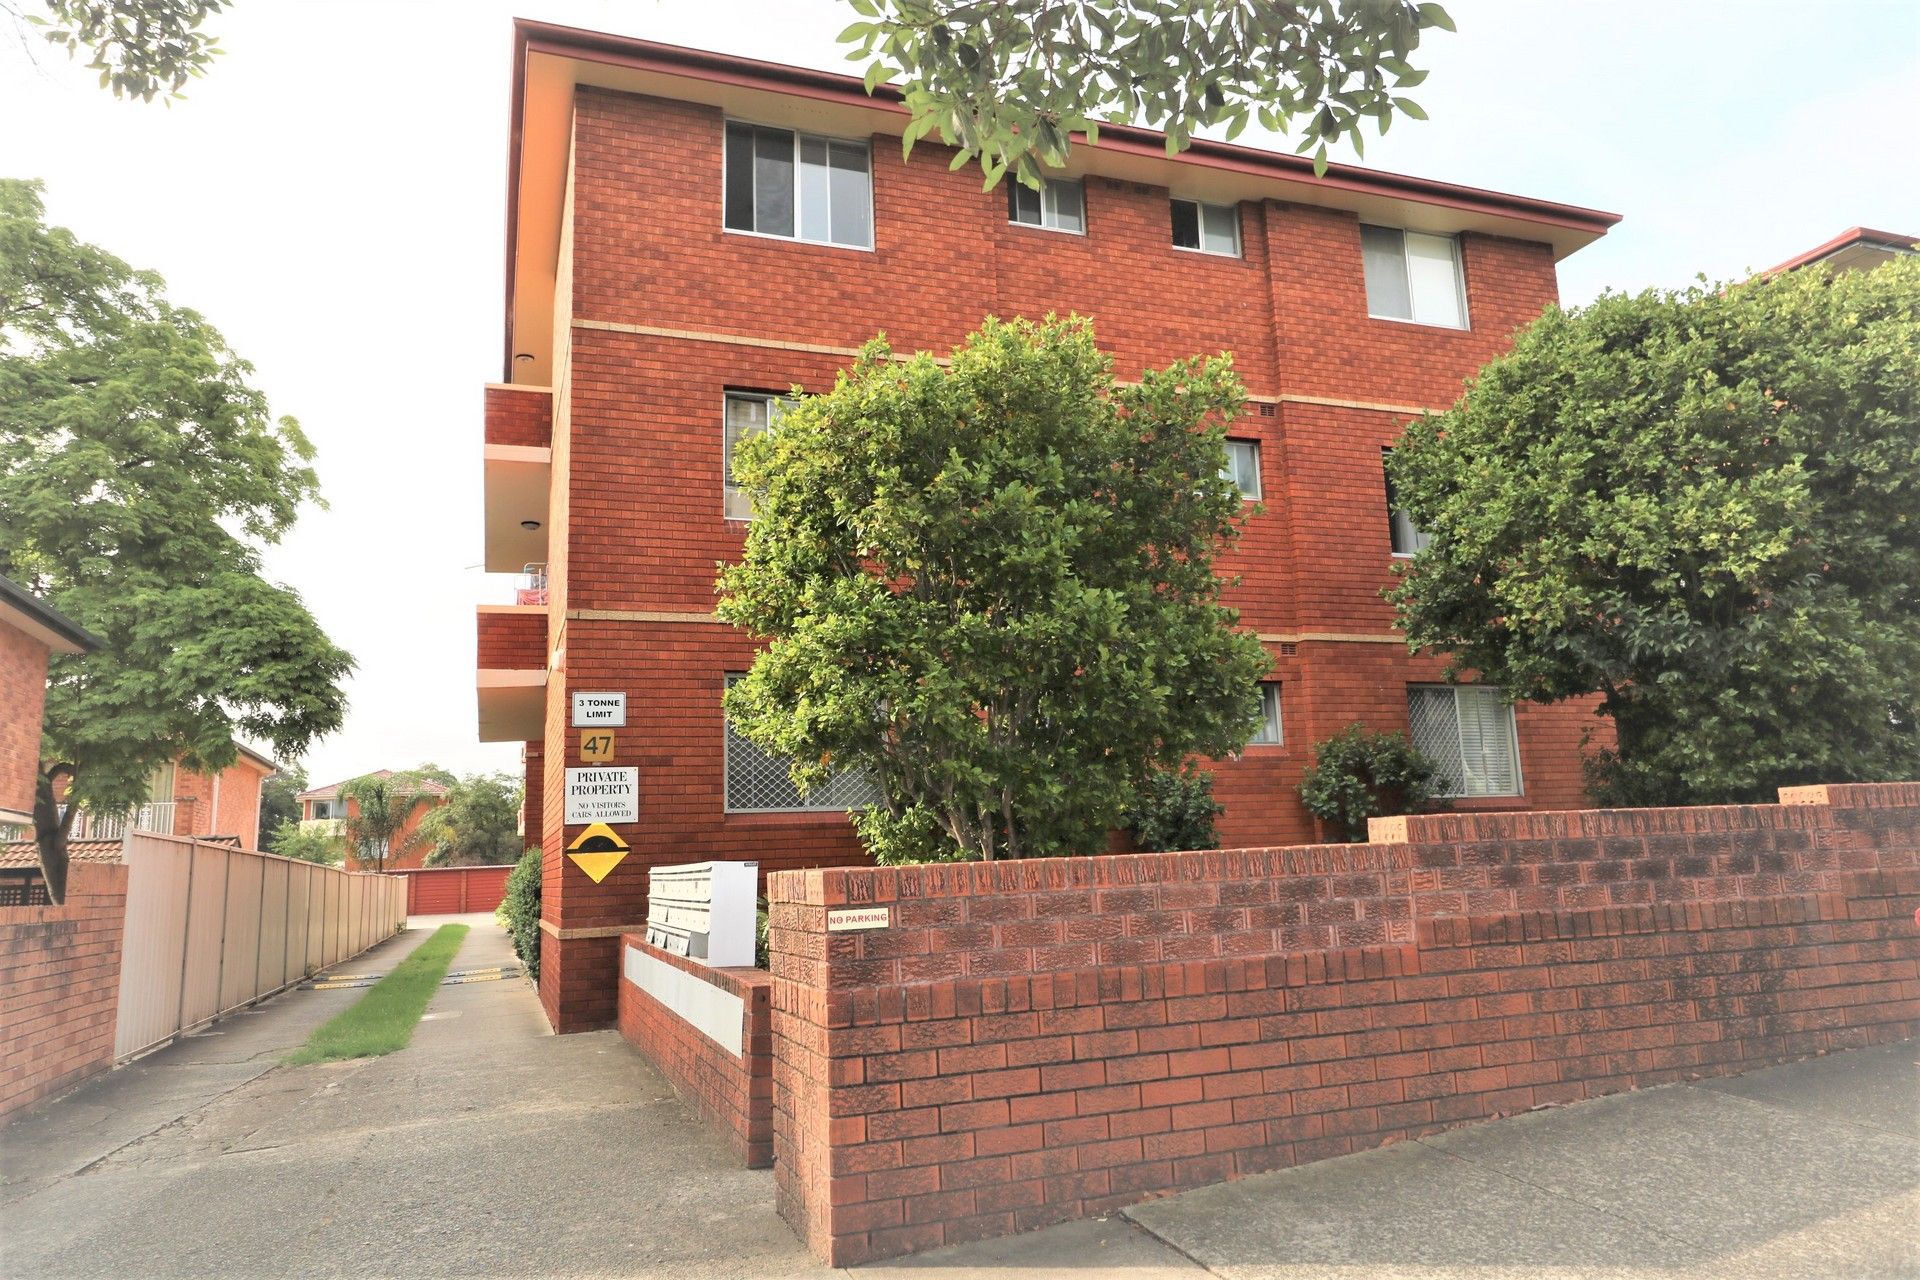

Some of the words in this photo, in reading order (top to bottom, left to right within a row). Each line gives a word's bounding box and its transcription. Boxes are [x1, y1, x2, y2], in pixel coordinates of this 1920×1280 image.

[579, 699, 585, 707] 3
[588, 699, 620, 707] TONNE
[583, 736, 611, 755] 47
[577, 771, 628, 782] PRIVATE
[571, 784, 632, 795] PROPERTY
[595, 810, 632, 818] ALLOWED
[829, 916, 844, 925] NO
[845, 913, 888, 924] PARKING
